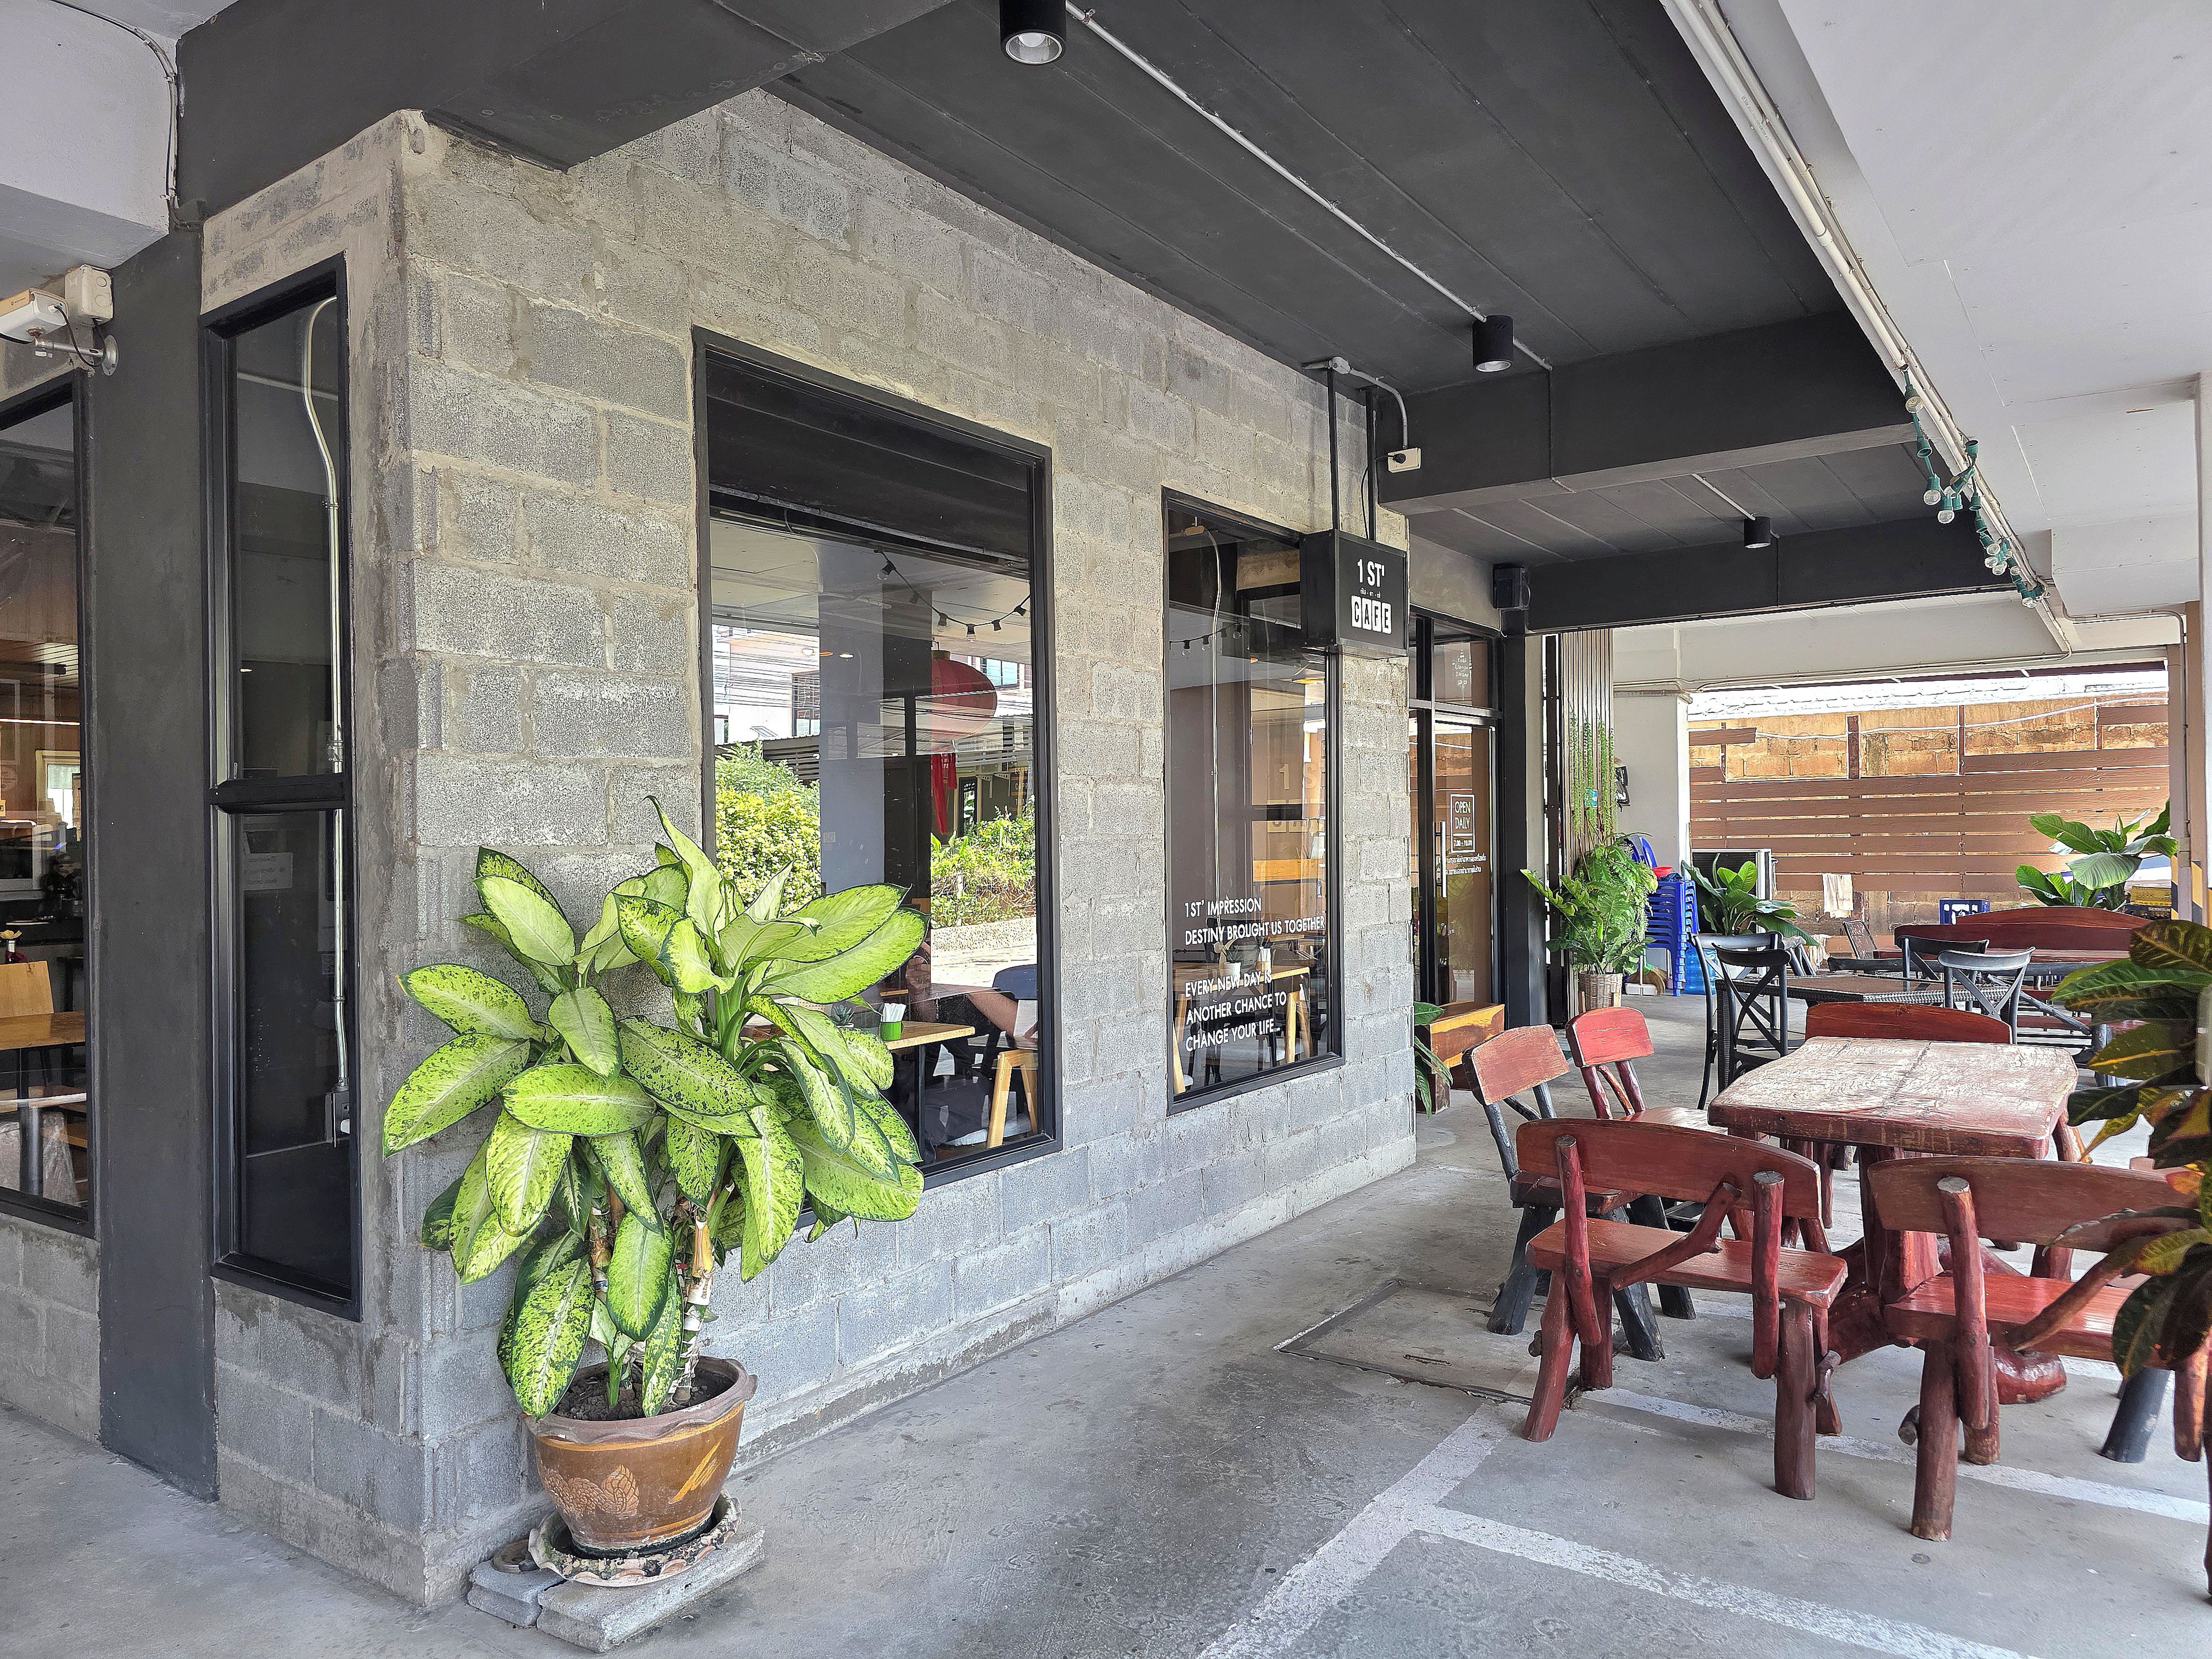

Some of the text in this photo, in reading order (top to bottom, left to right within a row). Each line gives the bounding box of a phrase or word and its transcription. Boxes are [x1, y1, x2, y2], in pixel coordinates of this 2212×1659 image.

[1357, 559, 1363, 583] 1
[1353, 597, 1390, 631] CAFE
[1455, 801, 1471, 813] OPEN
[1455, 817, 1471, 830] DAILY
[1207, 897, 1262, 916] IMPRESSION
[1185, 915, 1325, 945] DESTINY BROUGHT US TOGETHER
[1185, 969, 1272, 998] EVERY NEW DAY IS
[1185, 991, 1287, 1025] ANOTHER CHANCE TO
[1185, 1028, 1229, 1052] CHANGE
[1231, 1022, 1257, 1042] YOUR
